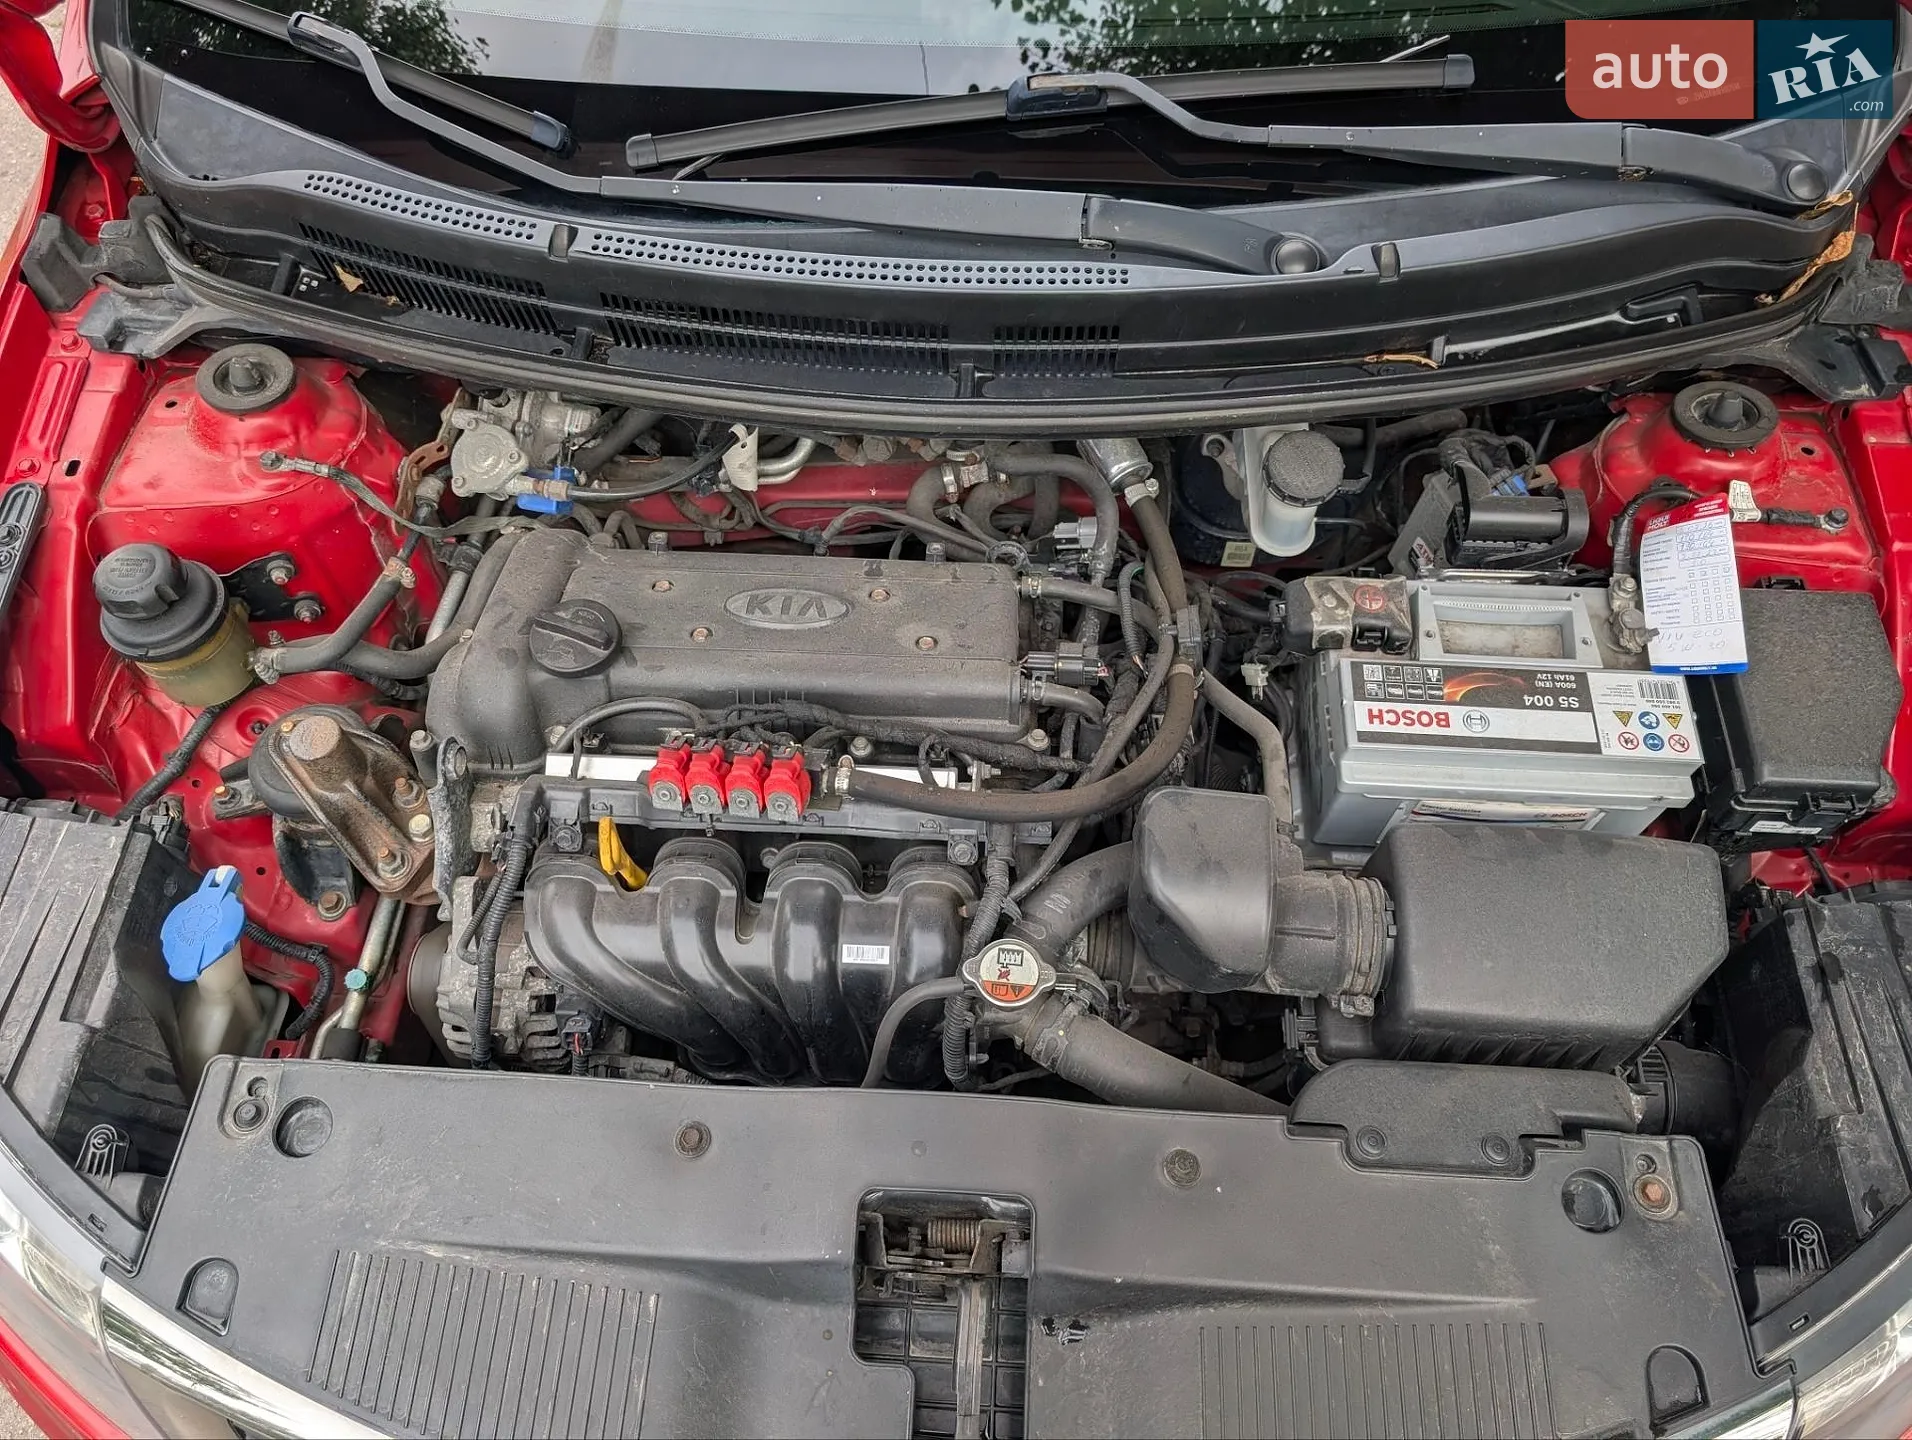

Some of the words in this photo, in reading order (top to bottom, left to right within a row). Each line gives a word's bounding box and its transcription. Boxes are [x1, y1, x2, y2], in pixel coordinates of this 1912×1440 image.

[745, 595, 828, 619] KIA
[1534, 679, 1553, 688] (EN)
[1553, 674, 1575, 682] 61Ah
[1554, 681, 1577, 689] 600A
[1523, 694, 1554, 707] 004
[1558, 696, 1580, 709] S5
[1367, 708, 1451, 729] BOSCH
